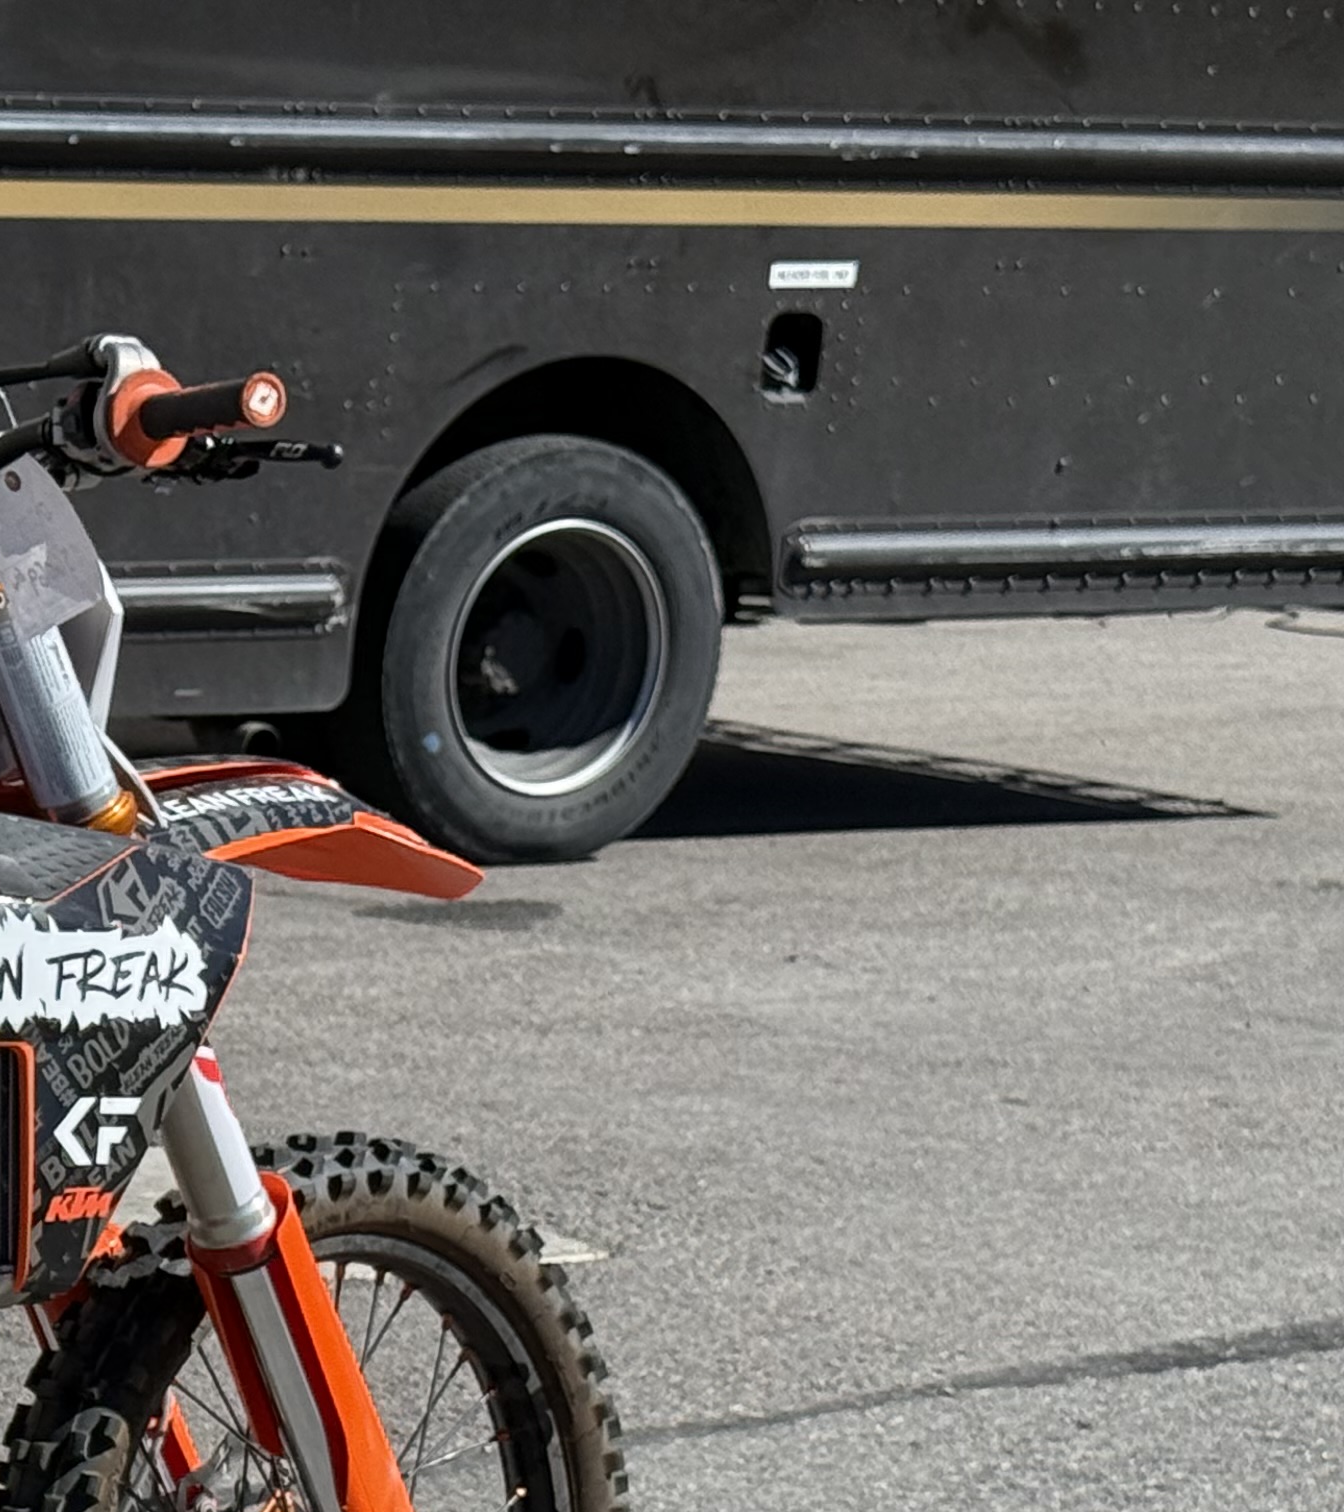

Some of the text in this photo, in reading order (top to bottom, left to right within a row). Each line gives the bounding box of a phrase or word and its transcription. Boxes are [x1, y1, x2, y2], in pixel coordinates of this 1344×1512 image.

[162, 784, 339, 823] LEAN FREAK
[46, 948, 195, 1002] FREAK
[67, 1019, 130, 1089] BOLD
[45, 1187, 113, 1223] KTM
